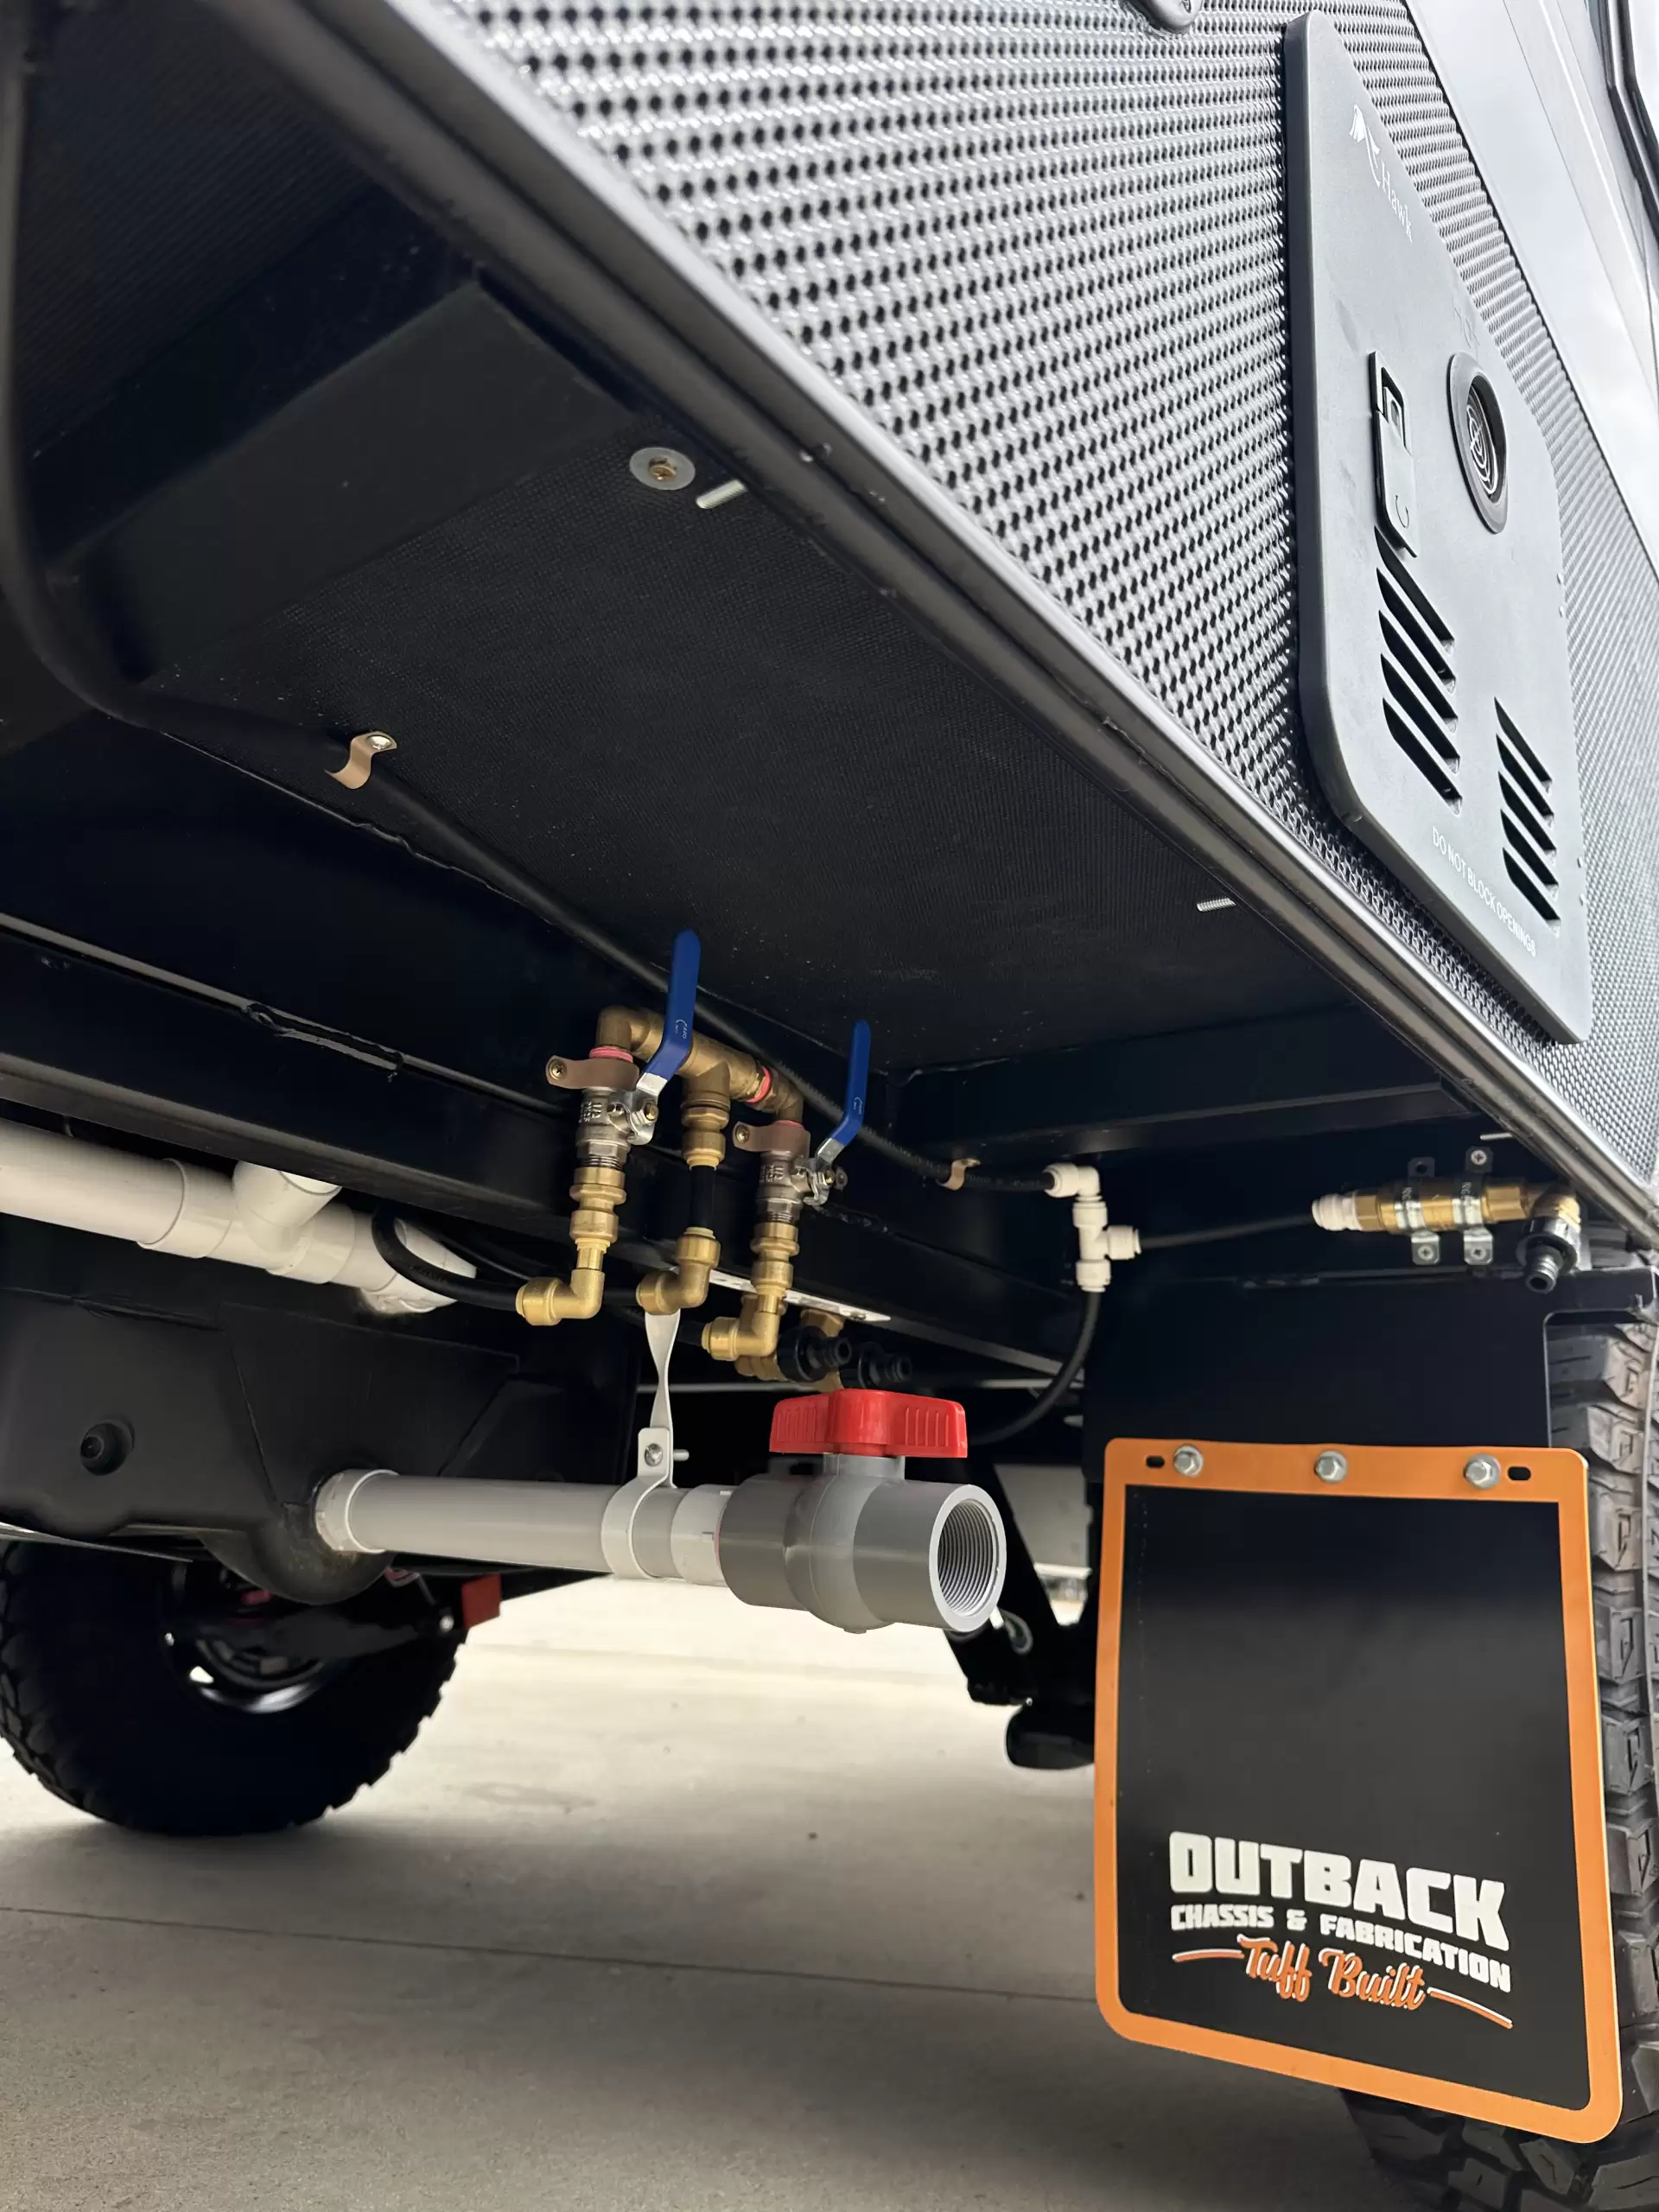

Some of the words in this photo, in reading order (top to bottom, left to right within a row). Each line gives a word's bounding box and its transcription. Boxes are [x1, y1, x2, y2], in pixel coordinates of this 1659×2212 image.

[1382, 159, 1413, 243] Hawk
[1433, 826, 1447, 855] DO
[1448, 844, 1467, 878] NOT
[1467, 867, 1497, 912] BLOCK
[1497, 901, 1536, 957] OPENINGS
[1169, 1831, 1510, 1951] OUTBACK
[1171, 1904, 1274, 1931] CHASSIS
[1286, 1909, 1307, 1931] &
[1319, 1913, 1511, 1993] FABRICATION
[1236, 1933, 1312, 2002] Tuff
[1318, 1947, 1427, 2011] Built
